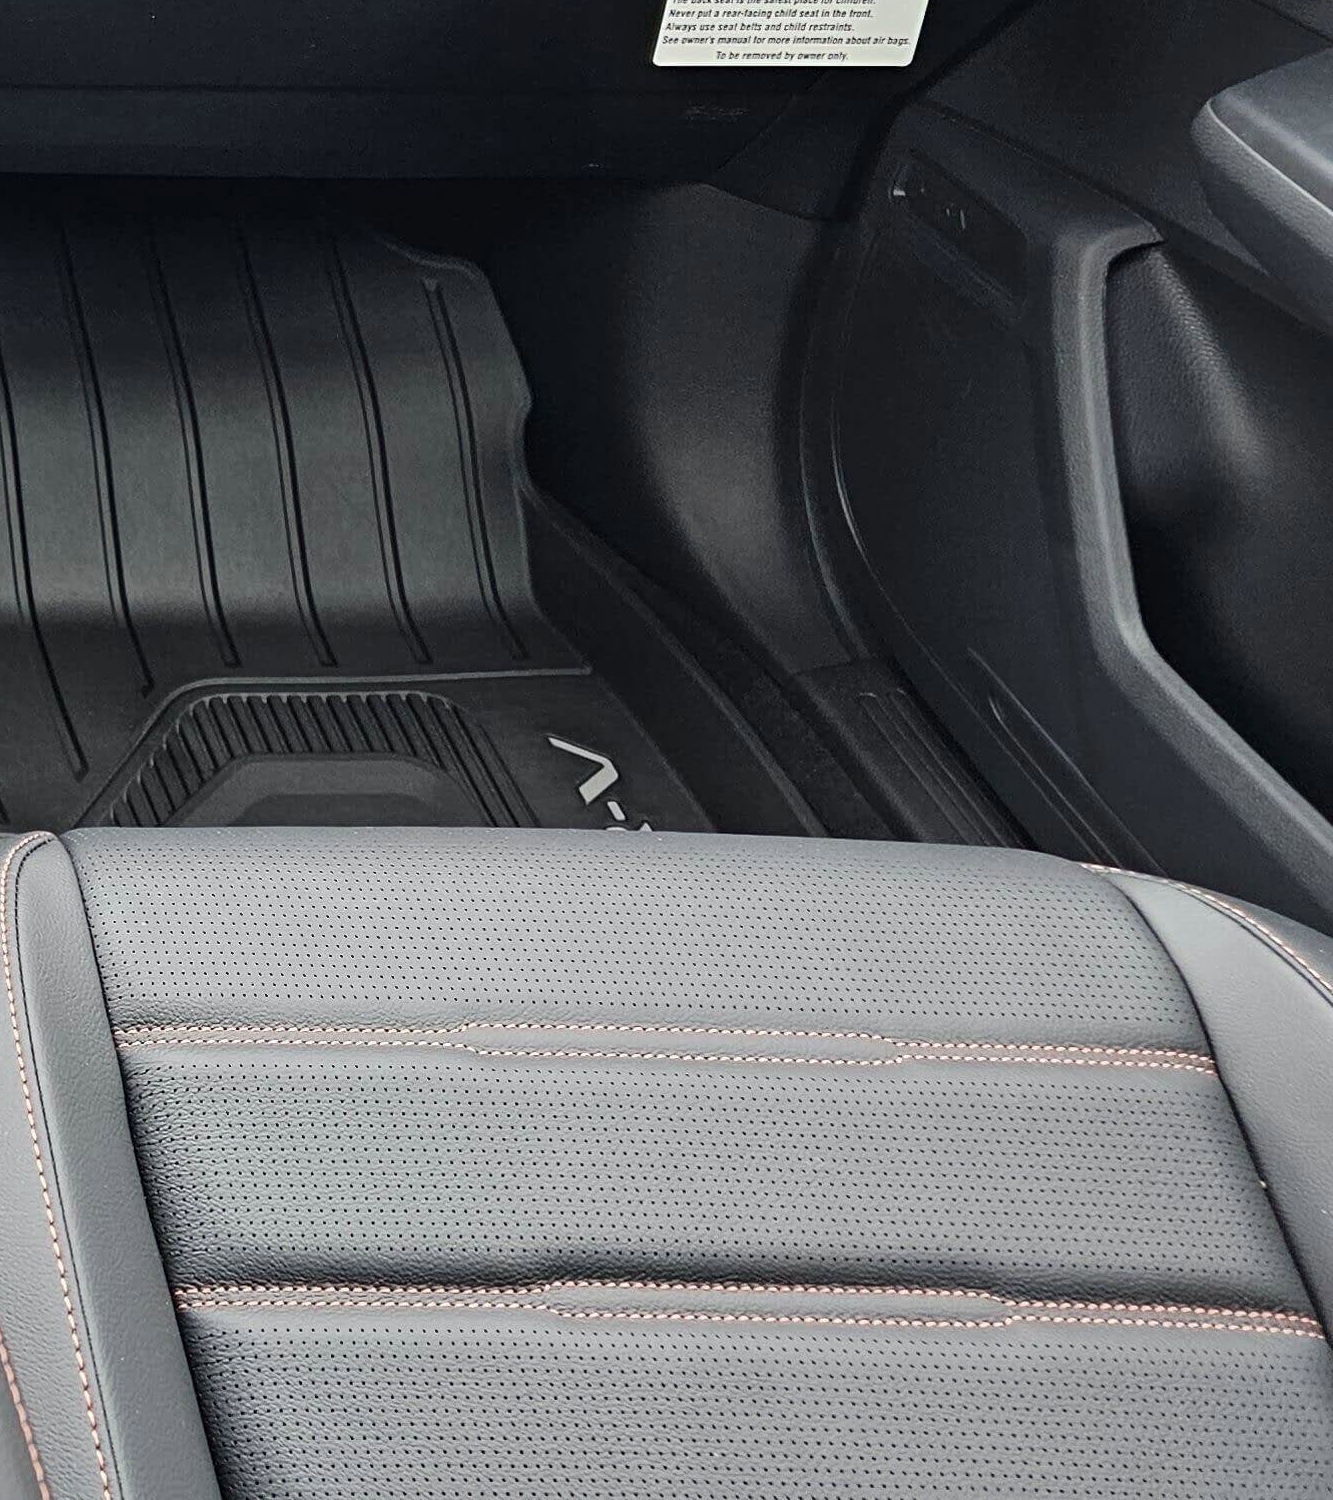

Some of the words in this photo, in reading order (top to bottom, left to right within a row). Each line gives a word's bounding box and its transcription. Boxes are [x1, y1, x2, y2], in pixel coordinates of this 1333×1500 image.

[669, 9, 695, 17] Never
[697, 10, 712, 19] put
[722, 9, 772, 19] rear-facing
[774, 9, 797, 17] child
[799, 9, 819, 17] seat
[821, 9, 830, 17] in
[832, 9, 847, 17] the
[665, 23, 697, 32] Always
[717, 23, 738, 31] seat
[740, 23, 763, 31] belts
[764, 23, 782, 31] and
[784, 23, 806, 31] child
[662, 36, 679, 44] See
[681, 36, 715, 44] owner's
[717, 36, 751, 44] manual
[753, 36, 766, 44] for
[792, 36, 844, 44] information
[845, 37, 871, 45] about
[716, 51, 727, 59] To
[728, 51, 740, 59] be
[742, 51, 783, 59] removed
[784, 51, 797, 61] by
